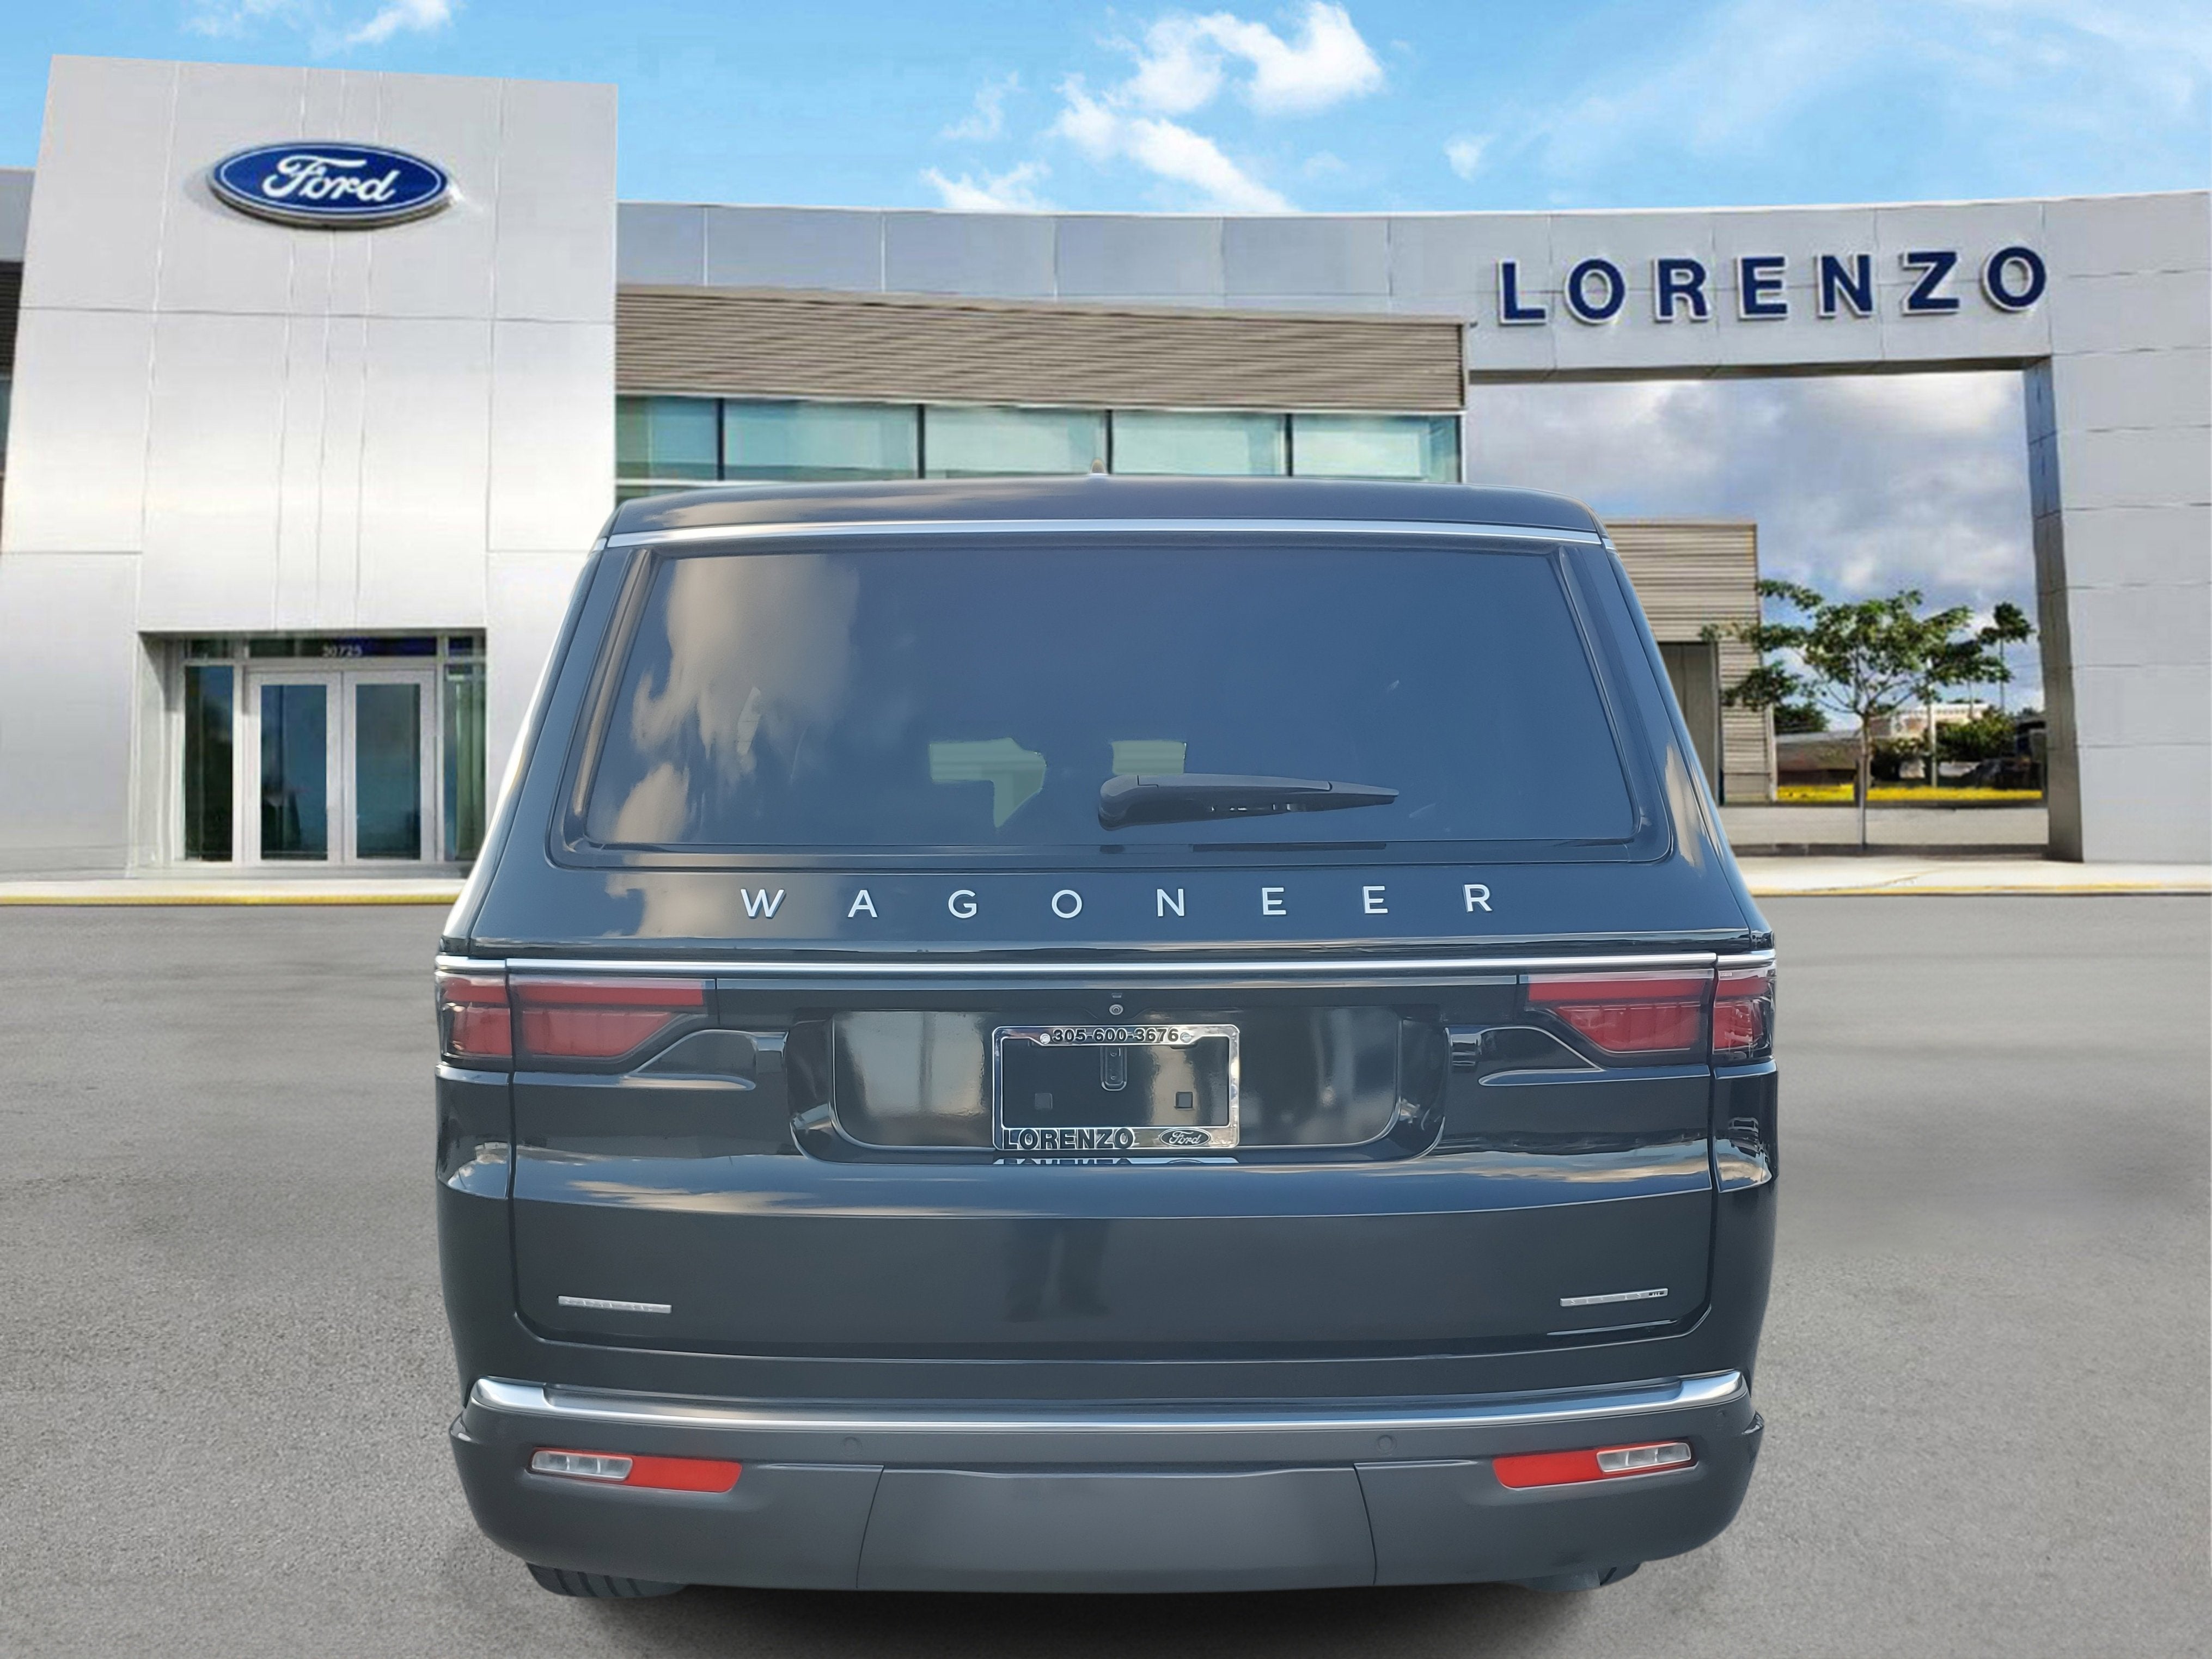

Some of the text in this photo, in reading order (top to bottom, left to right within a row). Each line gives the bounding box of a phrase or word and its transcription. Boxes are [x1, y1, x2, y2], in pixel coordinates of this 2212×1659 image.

[262, 155, 400, 201] Ford
[1499, 247, 2046, 326] LORENZO
[740, 884, 1493, 919] WAGONEER
[1052, 1028, 1180, 1043] 305-600-3676
[1003, 1128, 1135, 1149] LORENZO
[1169, 1130, 1202, 1144] Ford
